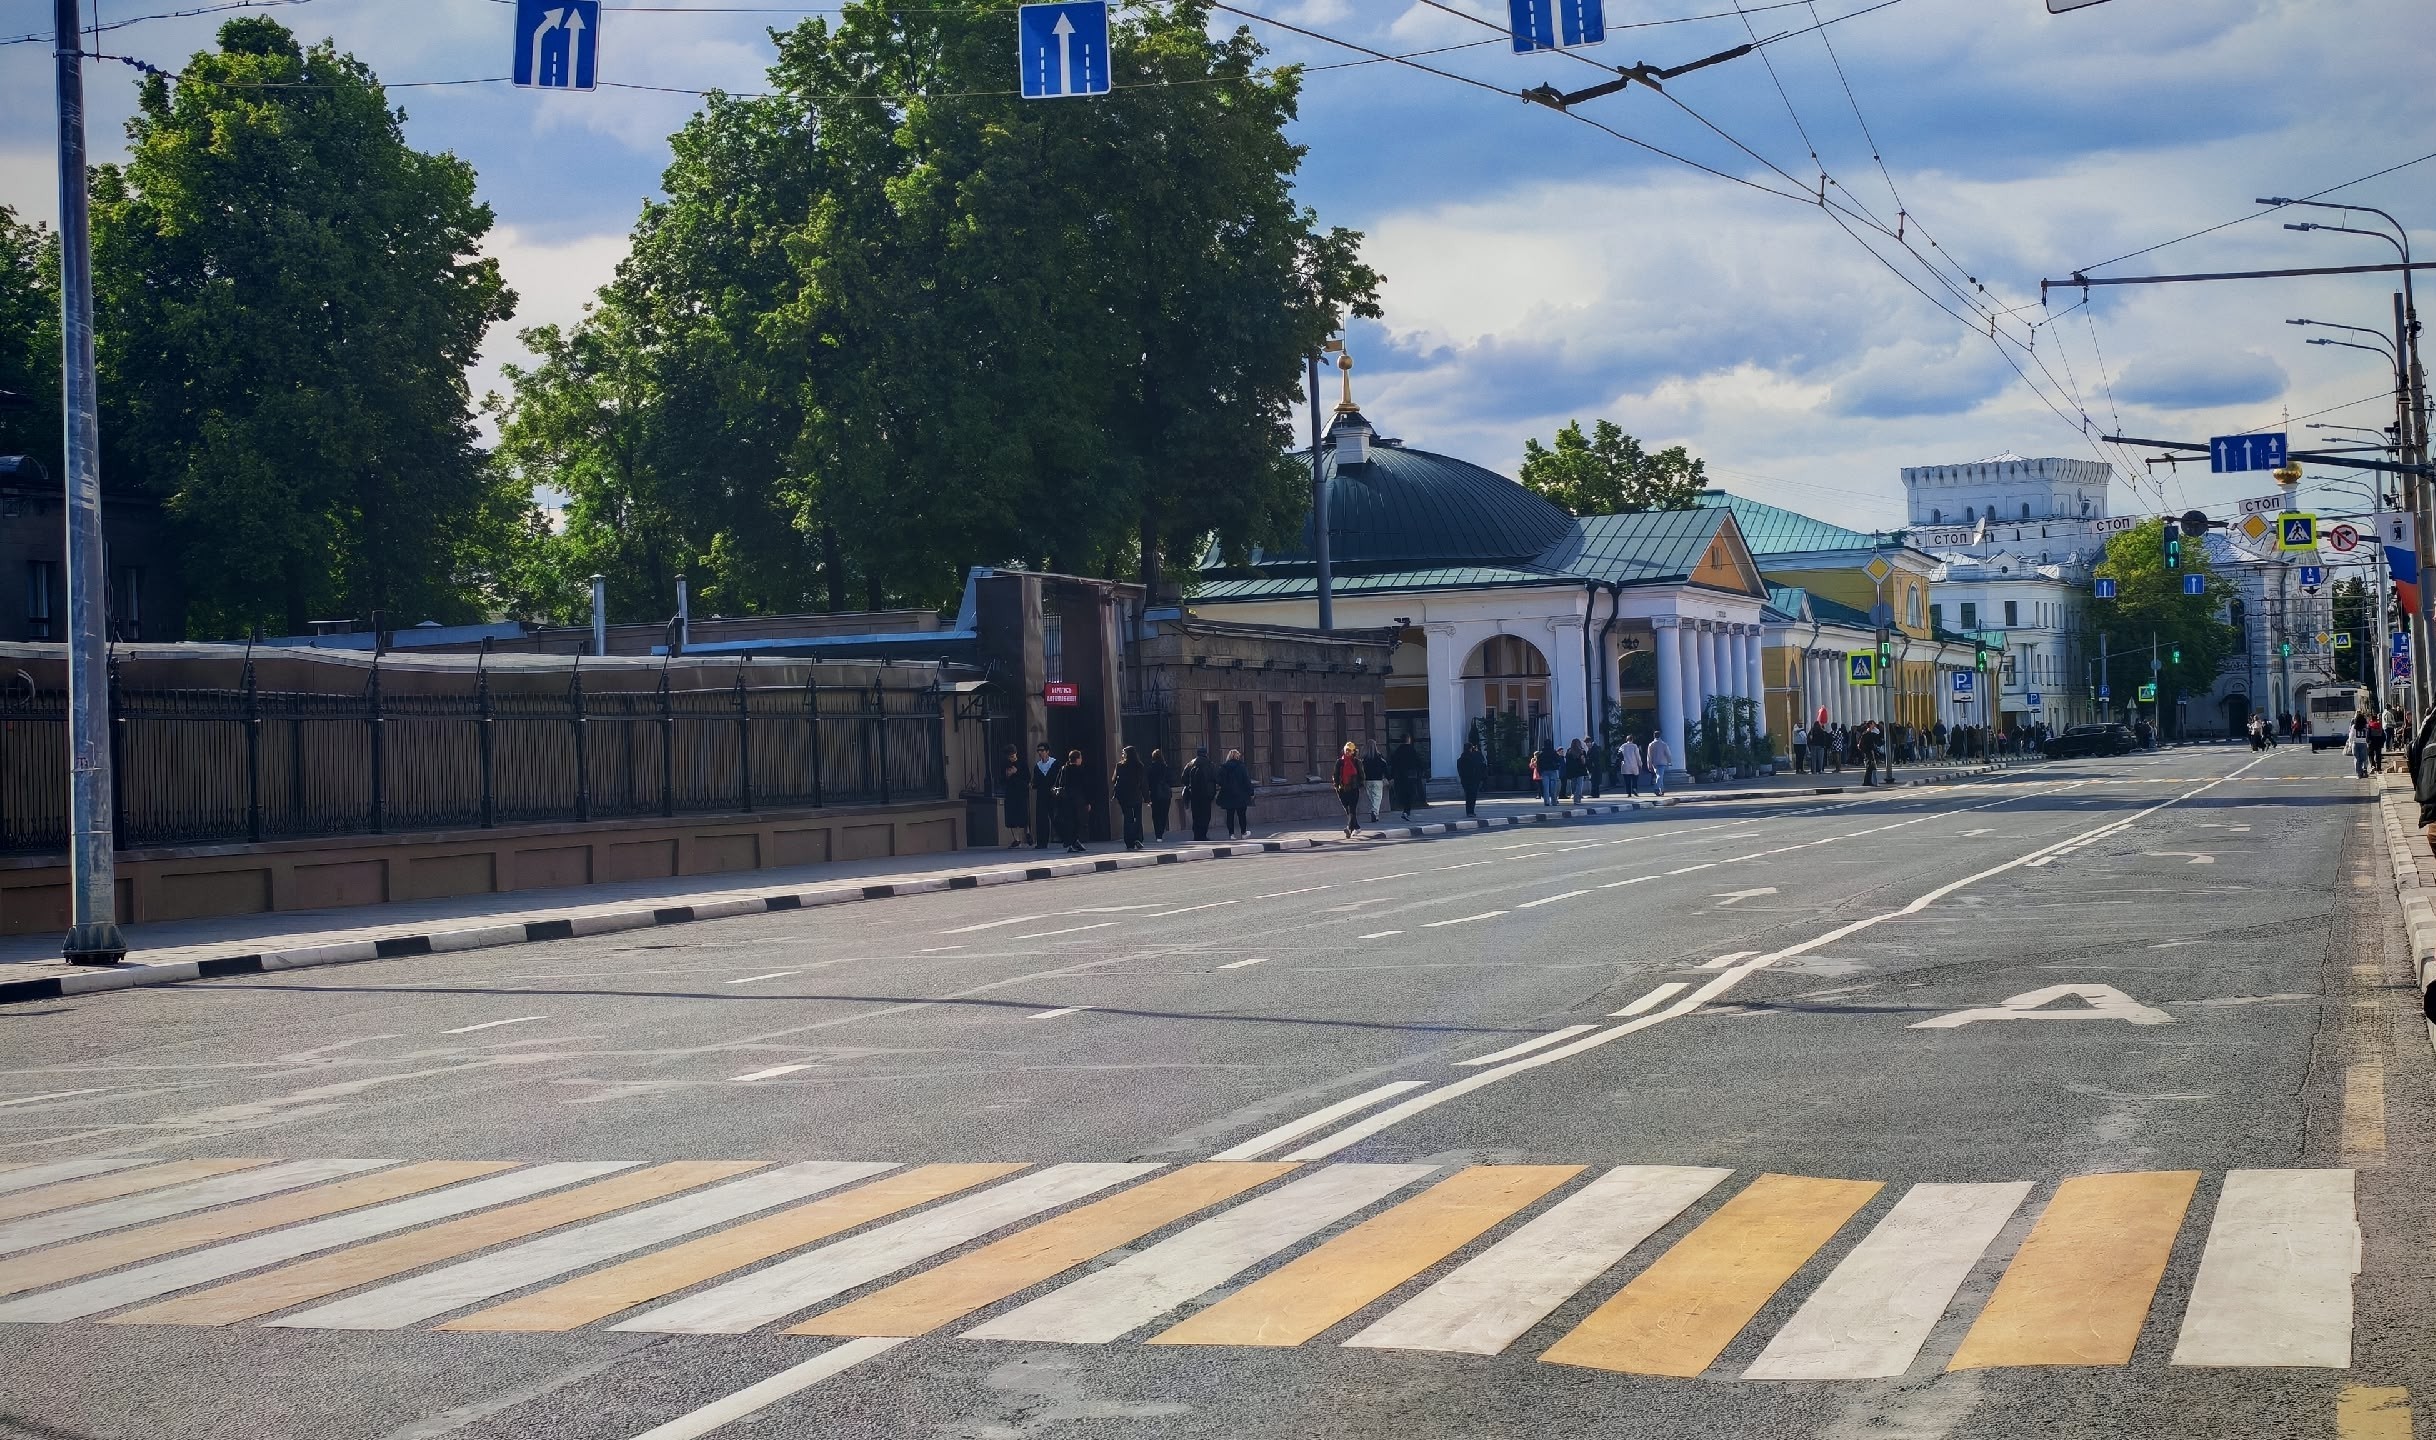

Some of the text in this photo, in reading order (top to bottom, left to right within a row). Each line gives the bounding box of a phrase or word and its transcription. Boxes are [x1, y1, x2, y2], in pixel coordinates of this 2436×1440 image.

[2245, 497, 2280, 512] СТОП
[2096, 517, 2130, 532] СТОП
[1934, 533, 1967, 545] СТОП
[1956, 673, 1968, 689] P
[2030, 693, 2038, 704] P
